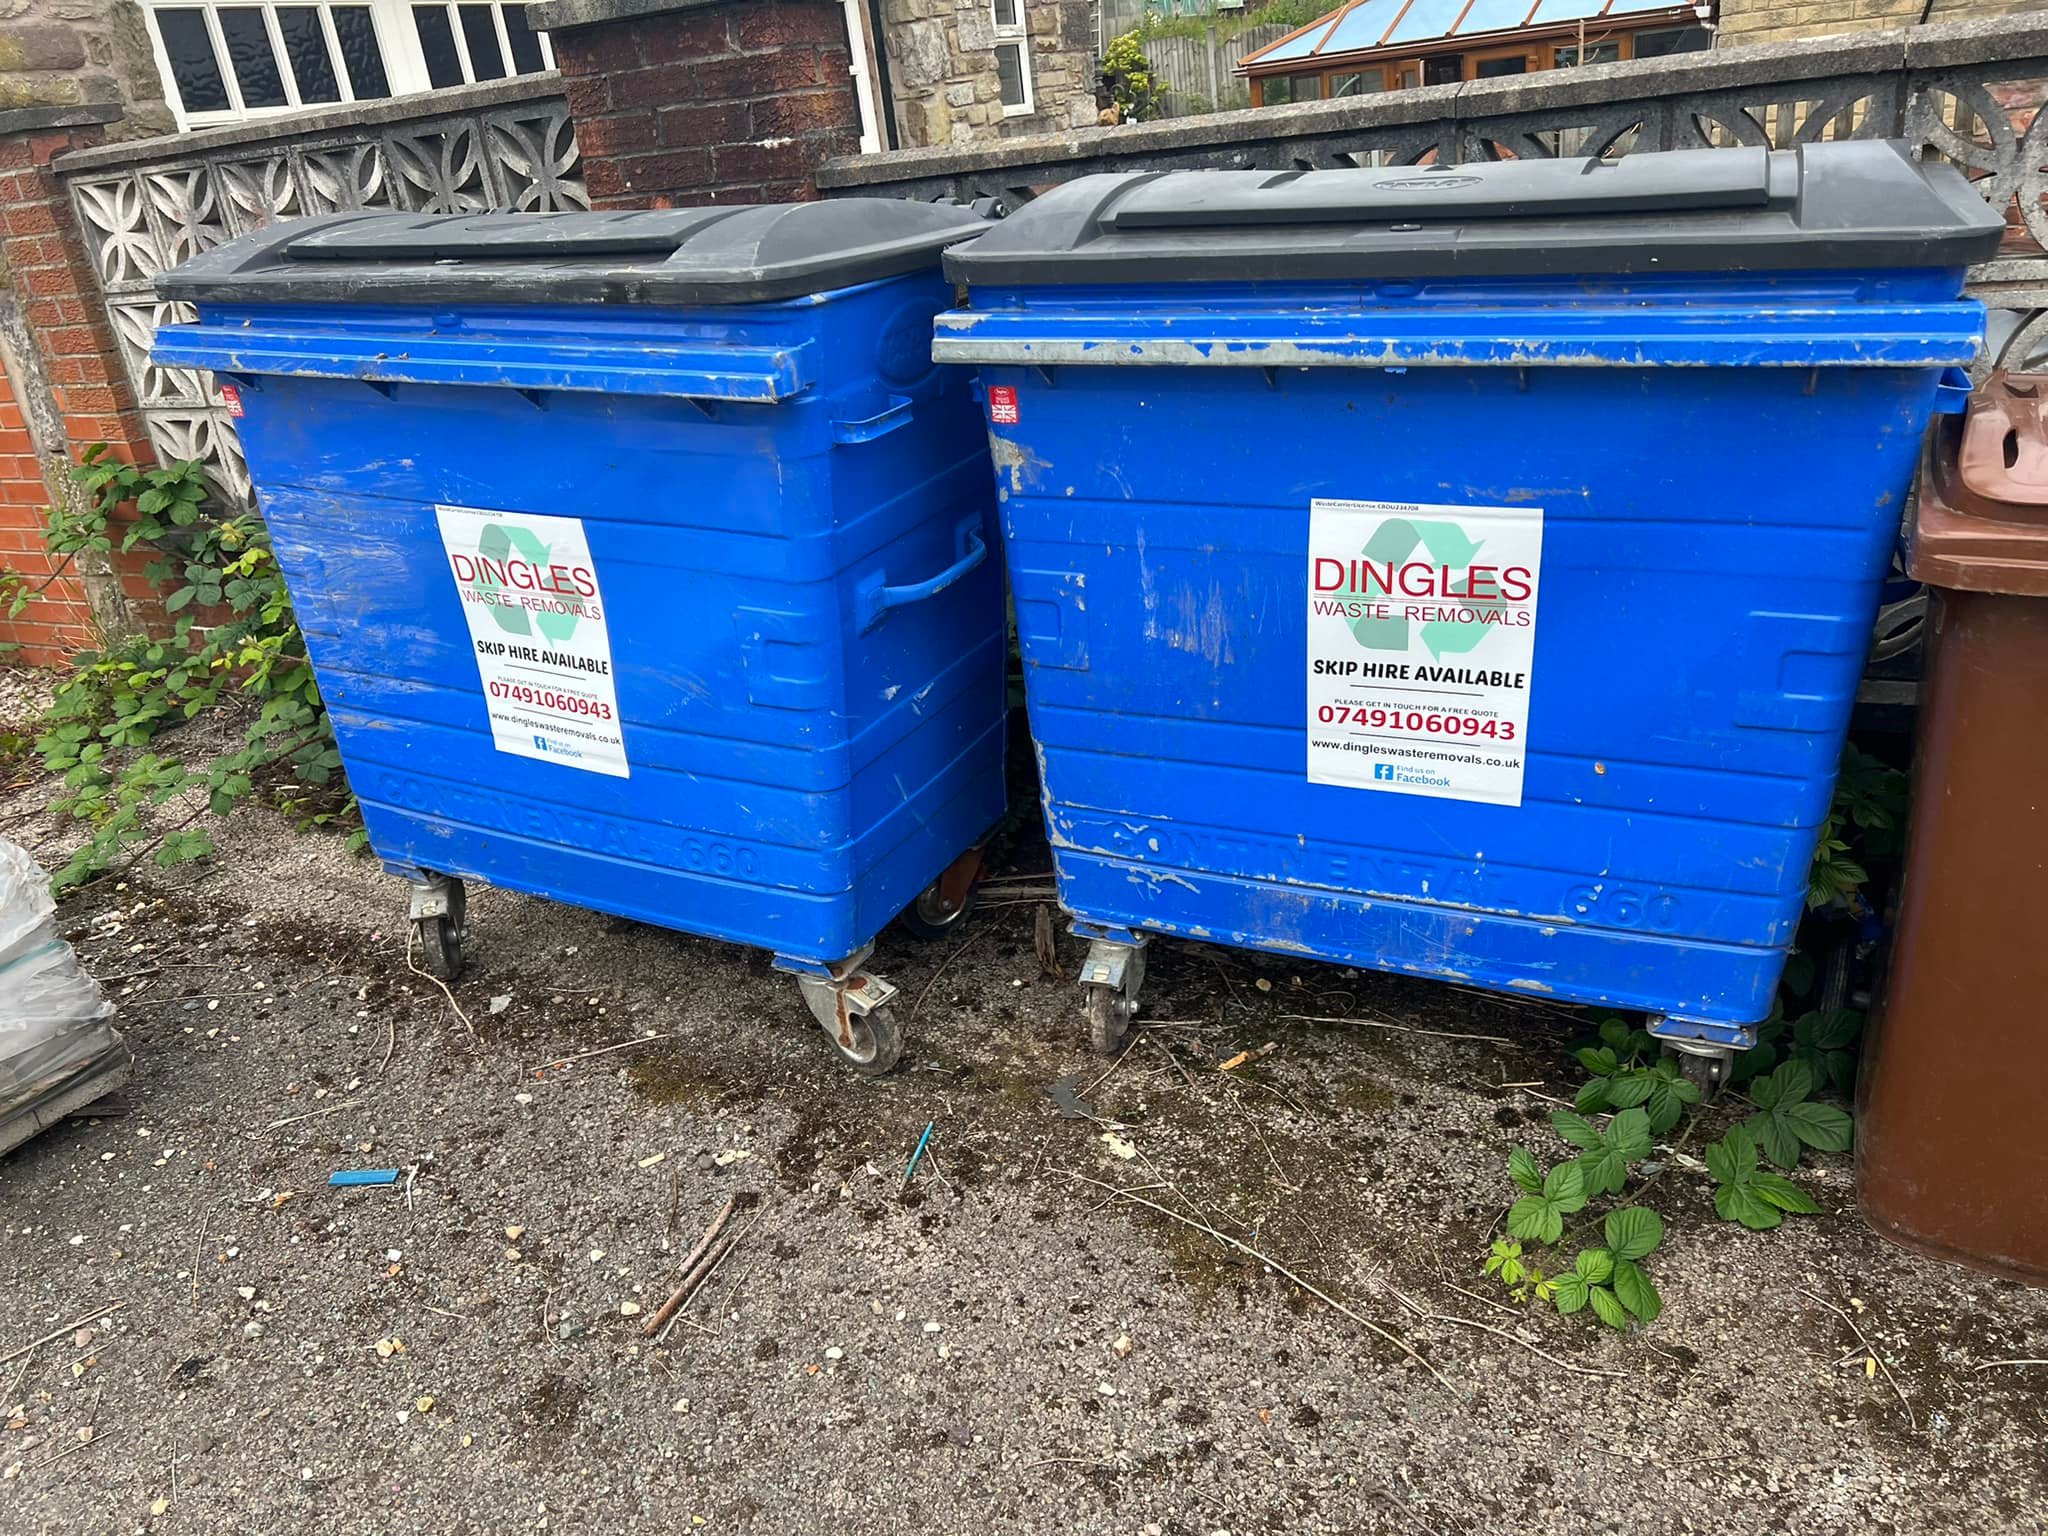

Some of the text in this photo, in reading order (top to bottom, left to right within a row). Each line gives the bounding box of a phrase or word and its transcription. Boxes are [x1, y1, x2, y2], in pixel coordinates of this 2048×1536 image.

[452, 554, 595, 597] DINGLES
[1315, 558, 1531, 601] DINGLES
[462, 590, 601, 620] WASTE REMOVALS
[1314, 601, 1530, 627] WASTE REMOVALS
[477, 640, 609, 675] SKIP HIRE AVAILABLE
[1313, 659, 1525, 689] SKIP HIRE AVAILABLE
[490, 681, 612, 720] 07491060943
[1448, 707, 1469, 715] FREE
[1471, 709, 1499, 718] QUOTE
[1318, 705, 1515, 740] 07491060943
[1311, 740, 1521, 769] www.dingleswasteremovals.co.uk
[1397, 764, 1413, 773] Find
[1397, 773, 1450, 787] Facebook
[681, 837, 761, 878] 660
[1106, 822, 1683, 931] CONTINENTAL 660
